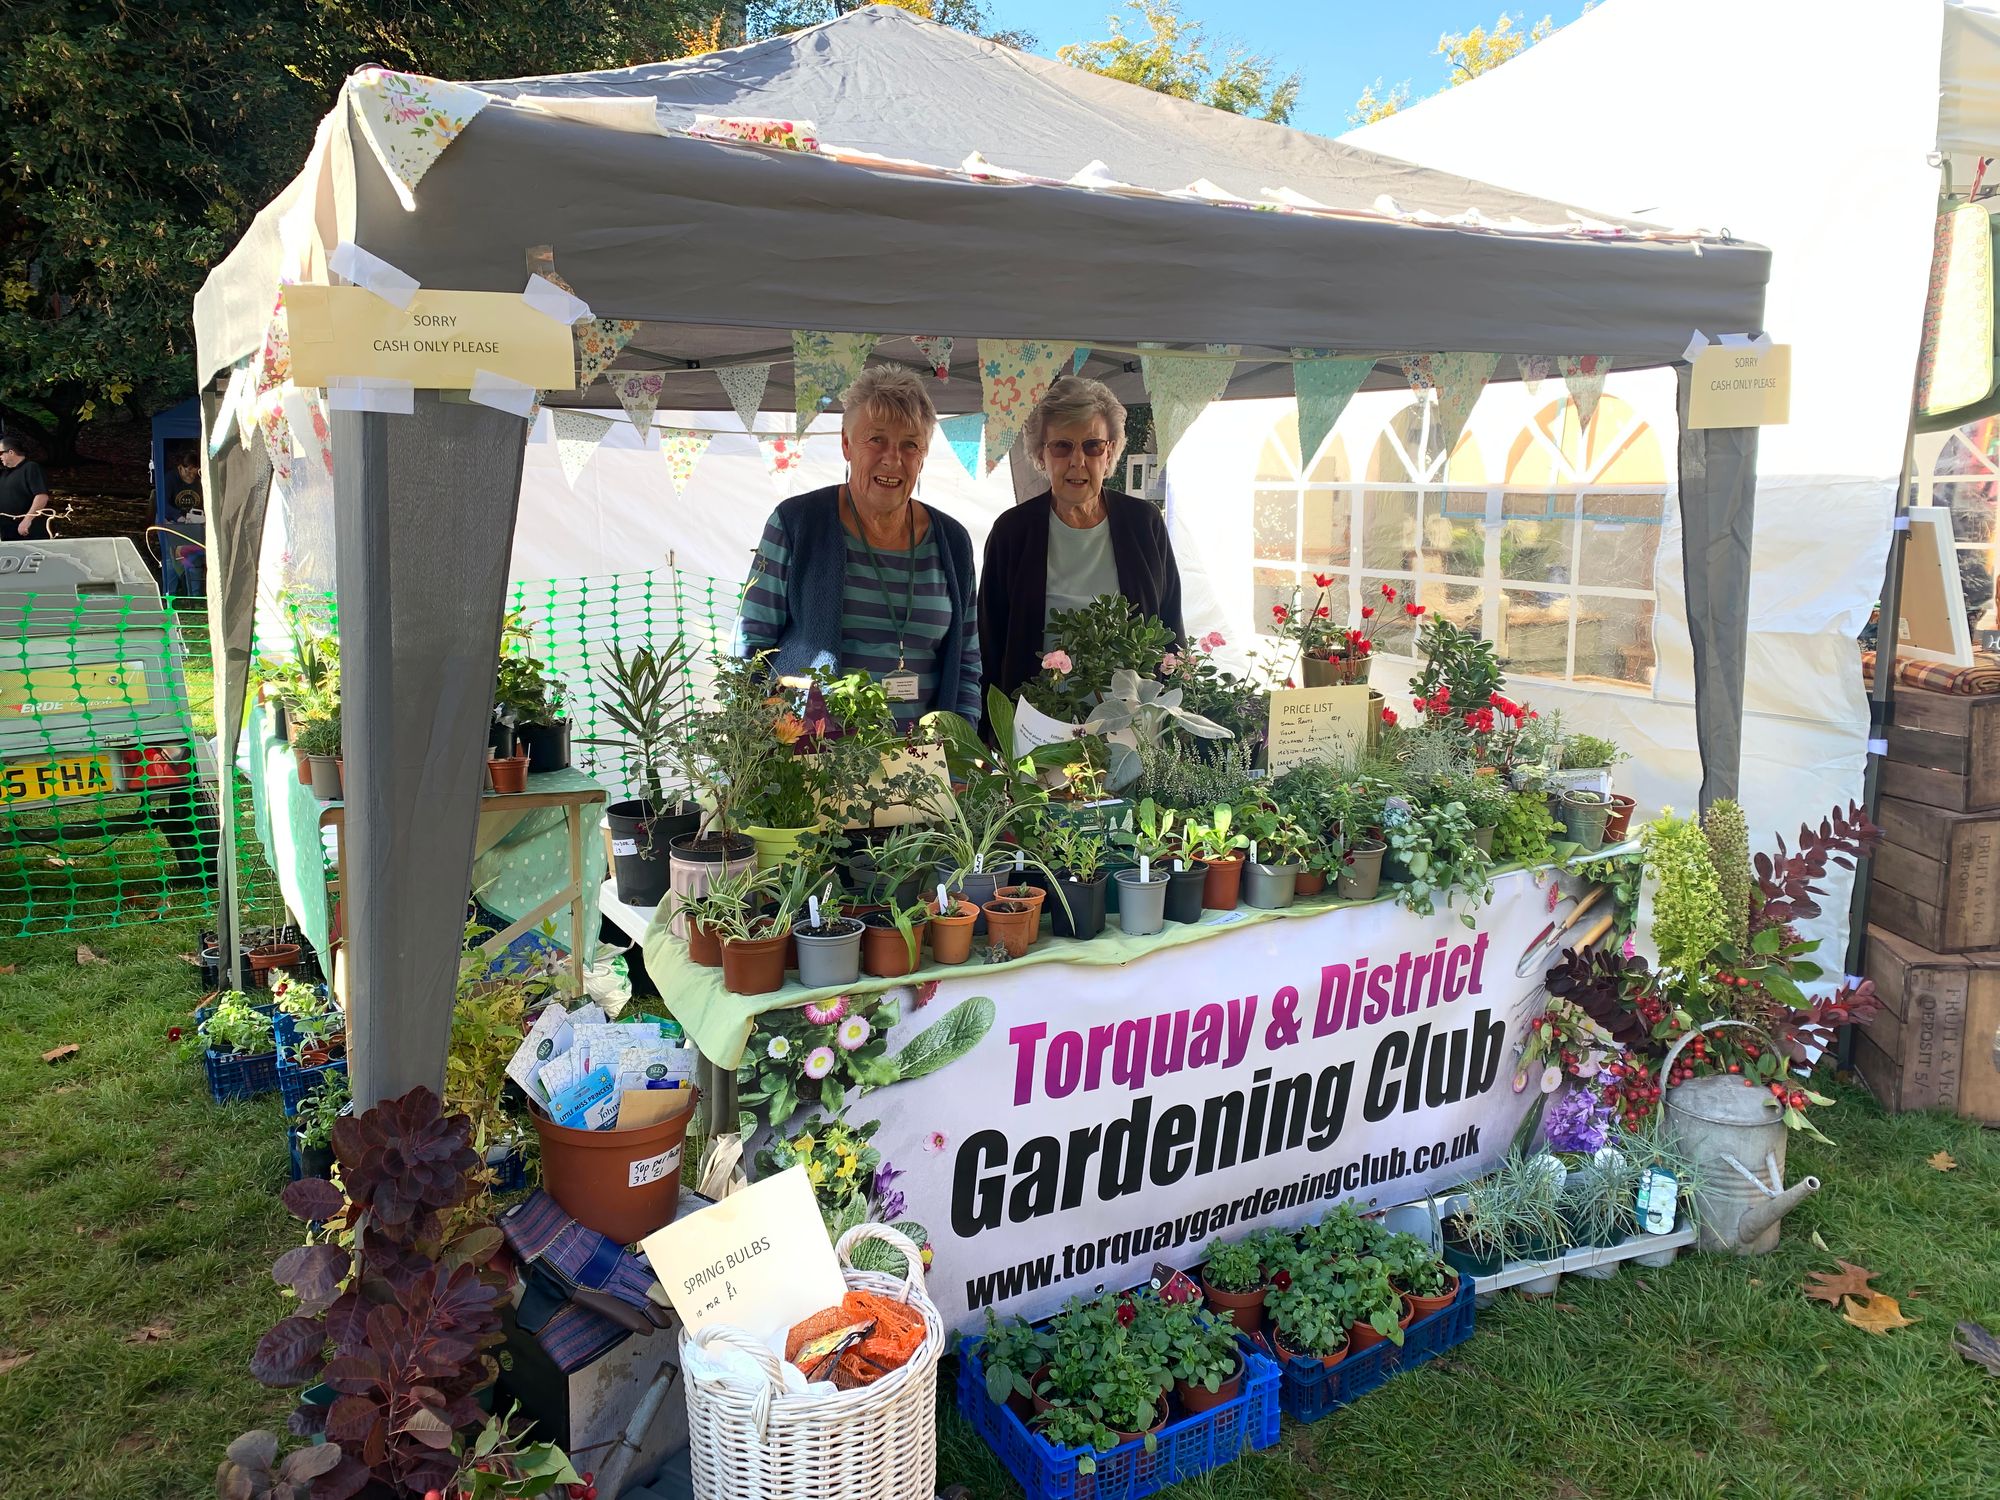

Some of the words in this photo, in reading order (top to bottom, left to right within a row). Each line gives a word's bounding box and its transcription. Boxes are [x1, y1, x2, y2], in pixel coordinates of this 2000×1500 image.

[413, 314, 457, 327] SORRY
[373, 339, 409, 352] CASH
[413, 340, 449, 352] ONLY
[453, 341, 500, 354] PLEASE
[1735, 357, 1759, 368] SORRY
[1710, 380, 1731, 391] CASH
[1732, 379, 1753, 390] ONLY
[1753, 377, 1776, 389] PLEASE
[20, 701, 63, 713] ERDE
[1283, 703, 1311, 715] PRICE
[1313, 702, 1333, 713] LIST
[0, 769, 27, 798] 5
[36, 760, 107, 795] FHA
[1976, 834, 1991, 880] FRUIT
[1009, 995, 1258, 1106] Torquay
[1265, 985, 1303, 1051] &
[1312, 932, 1489, 1039] District
[1918, 999, 1937, 1068] DEPOSIT
[1942, 988, 1961, 1046] FRUIT
[1941, 1050, 1955, 1063] &
[559, 1108, 574, 1123] LITTLE
[574, 1098, 589, 1112] MISS
[587, 1083, 613, 1102] PRINCESS
[1938, 1070, 1955, 1106] VEG
[951, 1061, 1356, 1238] Gardening
[1363, 1008, 1506, 1123] Club
[966, 1124, 1481, 1311] www.torquaygardeningclub.co.uk
[683, 1260, 725, 1295] SPRING
[725, 1236, 771, 1269] BULBS
